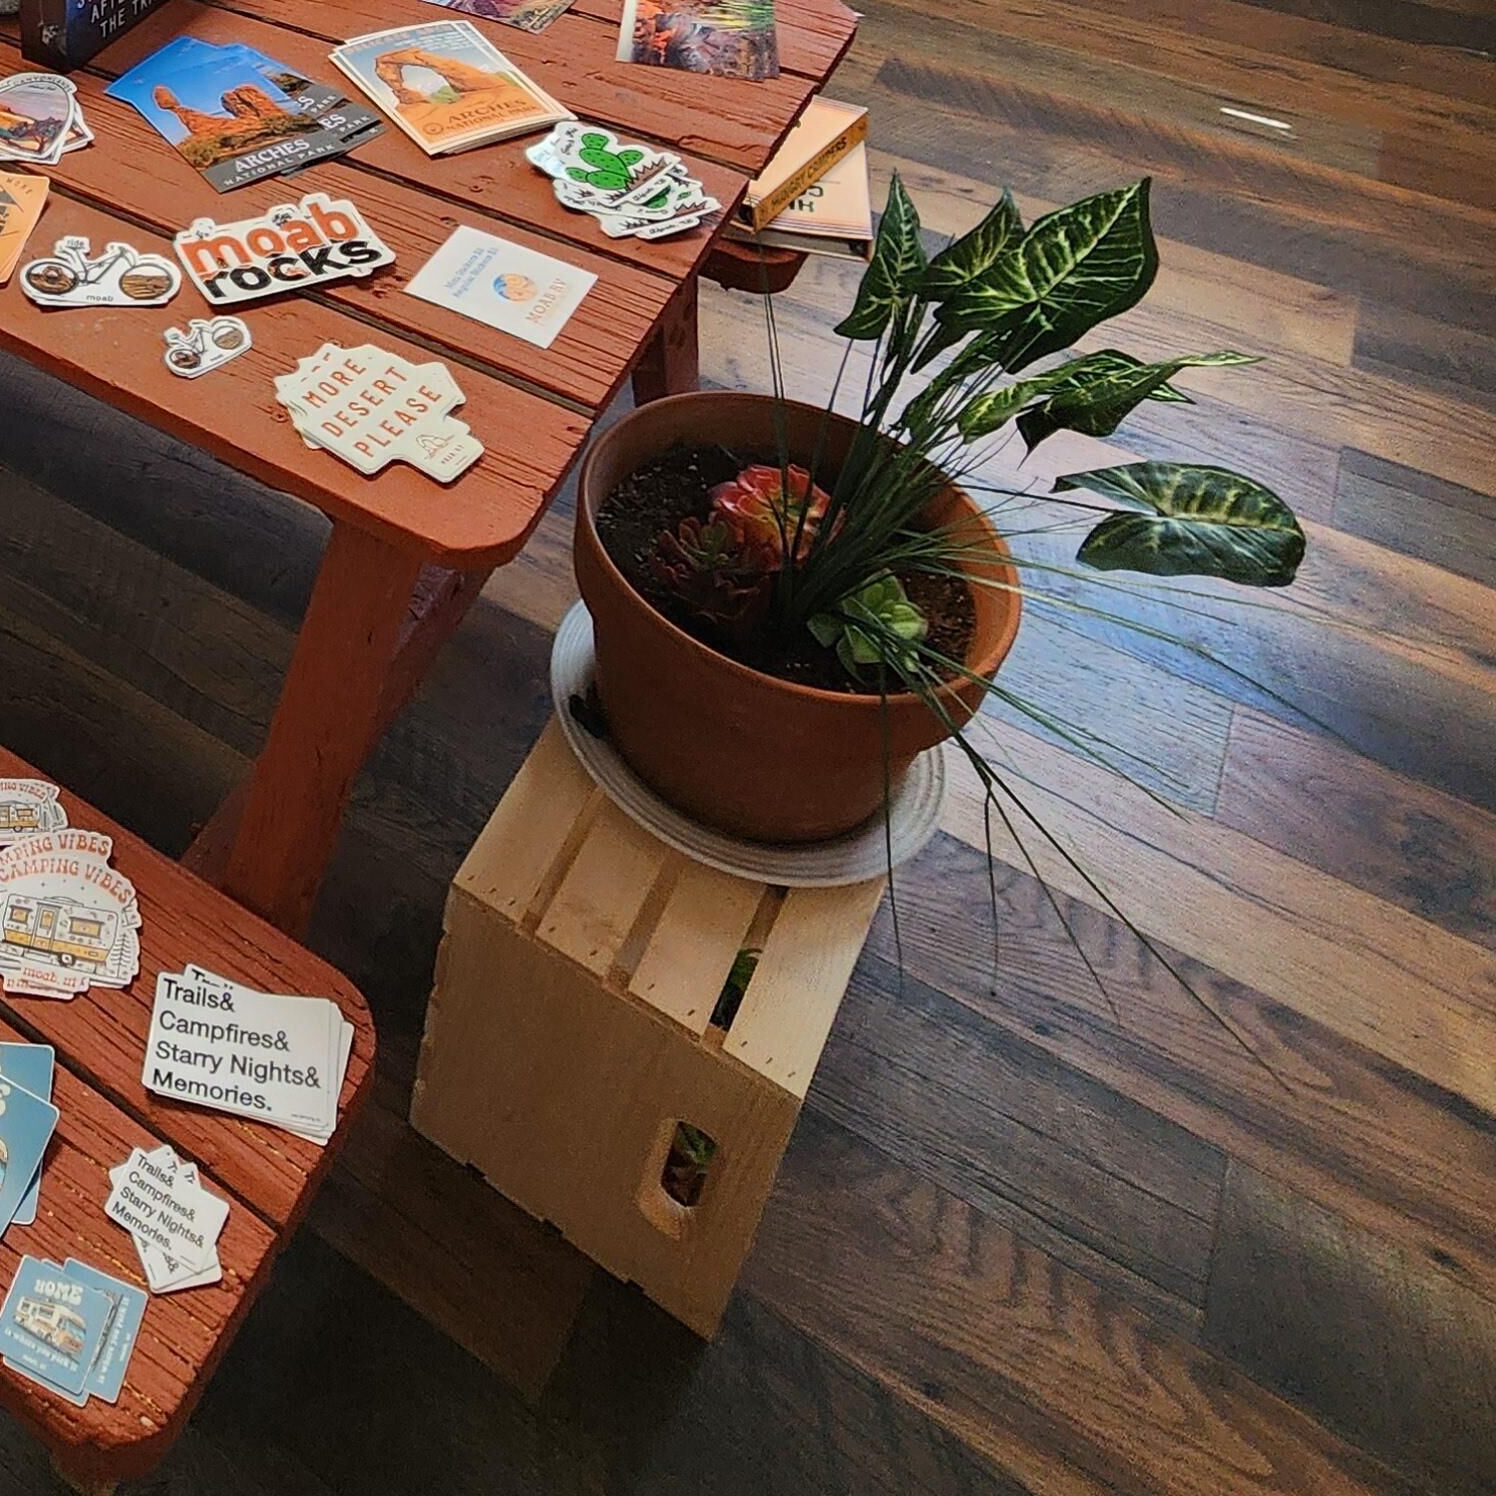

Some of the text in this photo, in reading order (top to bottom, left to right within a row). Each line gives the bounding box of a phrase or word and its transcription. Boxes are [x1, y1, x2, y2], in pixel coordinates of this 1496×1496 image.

[100, 14, 127, 39] THE
[448, 99, 528, 125] ARCHES
[223, 144, 335, 188] NATIONAL PARK
[233, 138, 311, 173] ARCHES
[184, 202, 360, 278] moab
[204, 239, 383, 300] rocks
[86, 293, 114, 304] moab
[302, 357, 369, 409] MORE
[320, 365, 409, 439] DESERT
[353, 383, 443, 460] PLEASE
[18, 782, 47, 801] VIBES
[57, 832, 111, 857] VIBES
[84, 863, 133, 905] VIBES
[163, 978, 236, 1013] Trails&
[158, 1010, 291, 1054] Campfires&
[155, 1038, 322, 1091] Starry Nights&
[151, 1067, 274, 1112] Memories.
[138, 1153, 175, 1188] Trails&
[120, 1186, 206, 1249] Starry Nights&
[128, 1170, 196, 1223] Campfires&
[111, 1200, 173, 1251] Memories.
[33, 1279, 84, 1306] HOME
